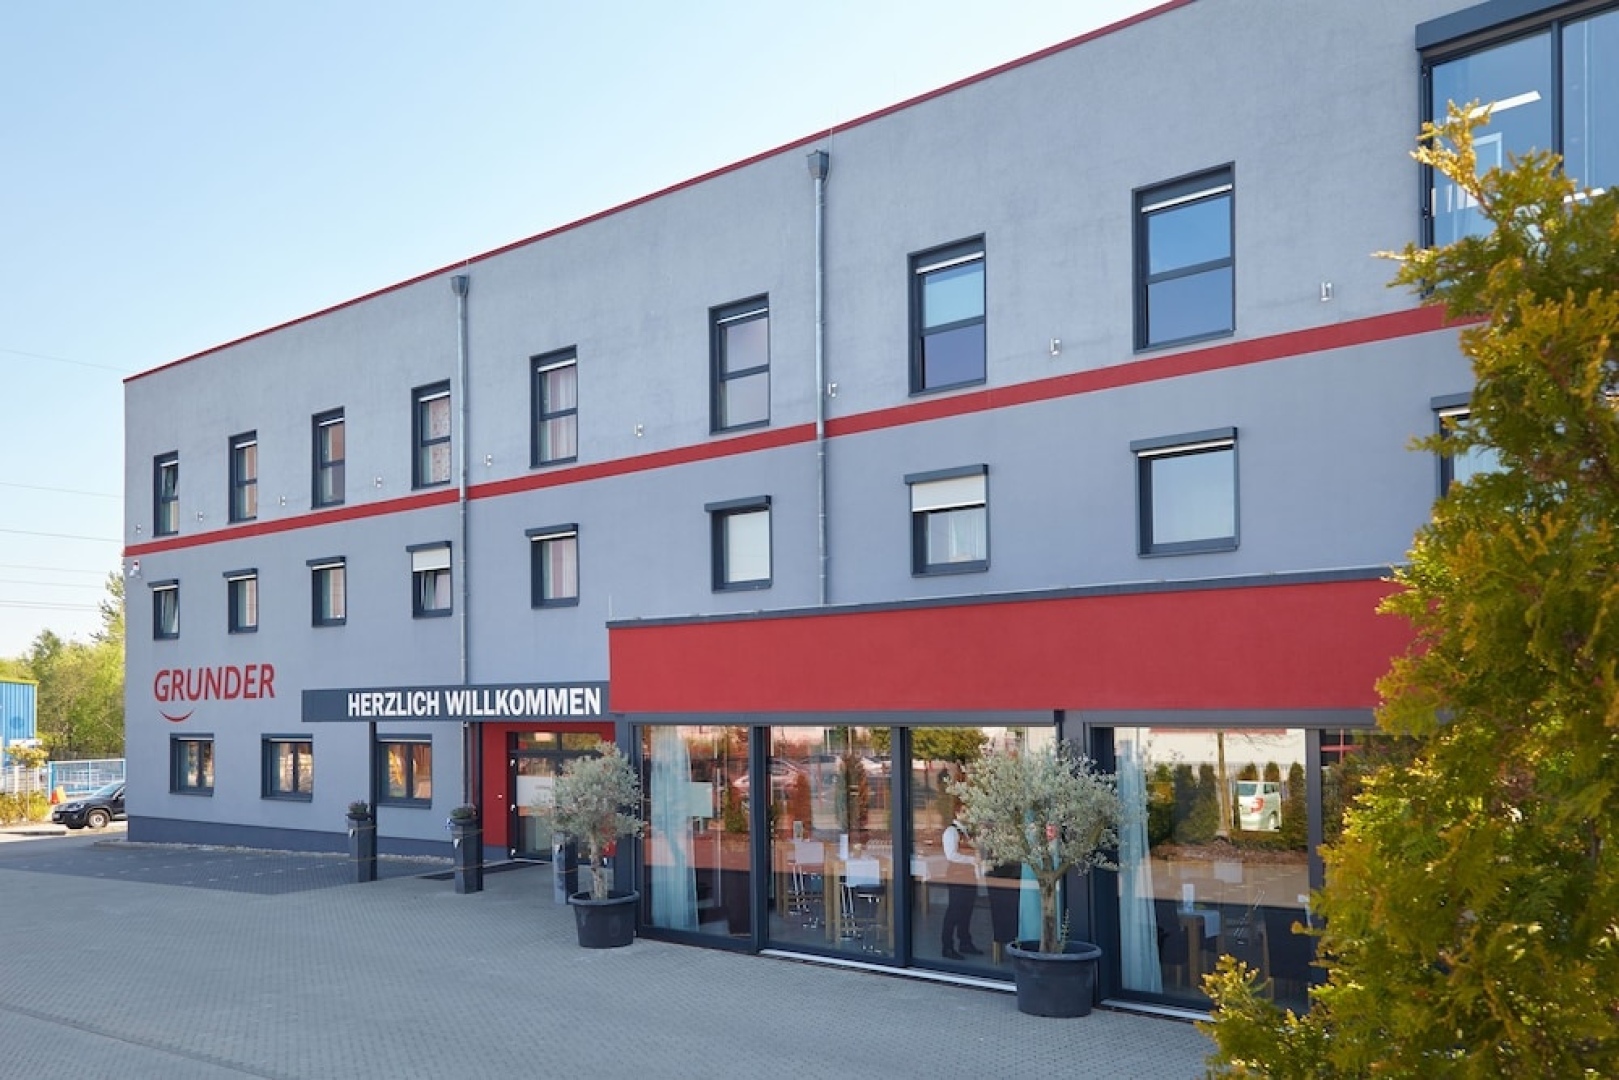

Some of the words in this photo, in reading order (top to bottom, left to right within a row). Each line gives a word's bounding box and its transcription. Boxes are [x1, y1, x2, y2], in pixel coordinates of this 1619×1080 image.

[154, 664, 275, 702] GRUNDER
[347, 691, 440, 717] HERZLICH
[445, 687, 601, 716] WILLKOMMEN
